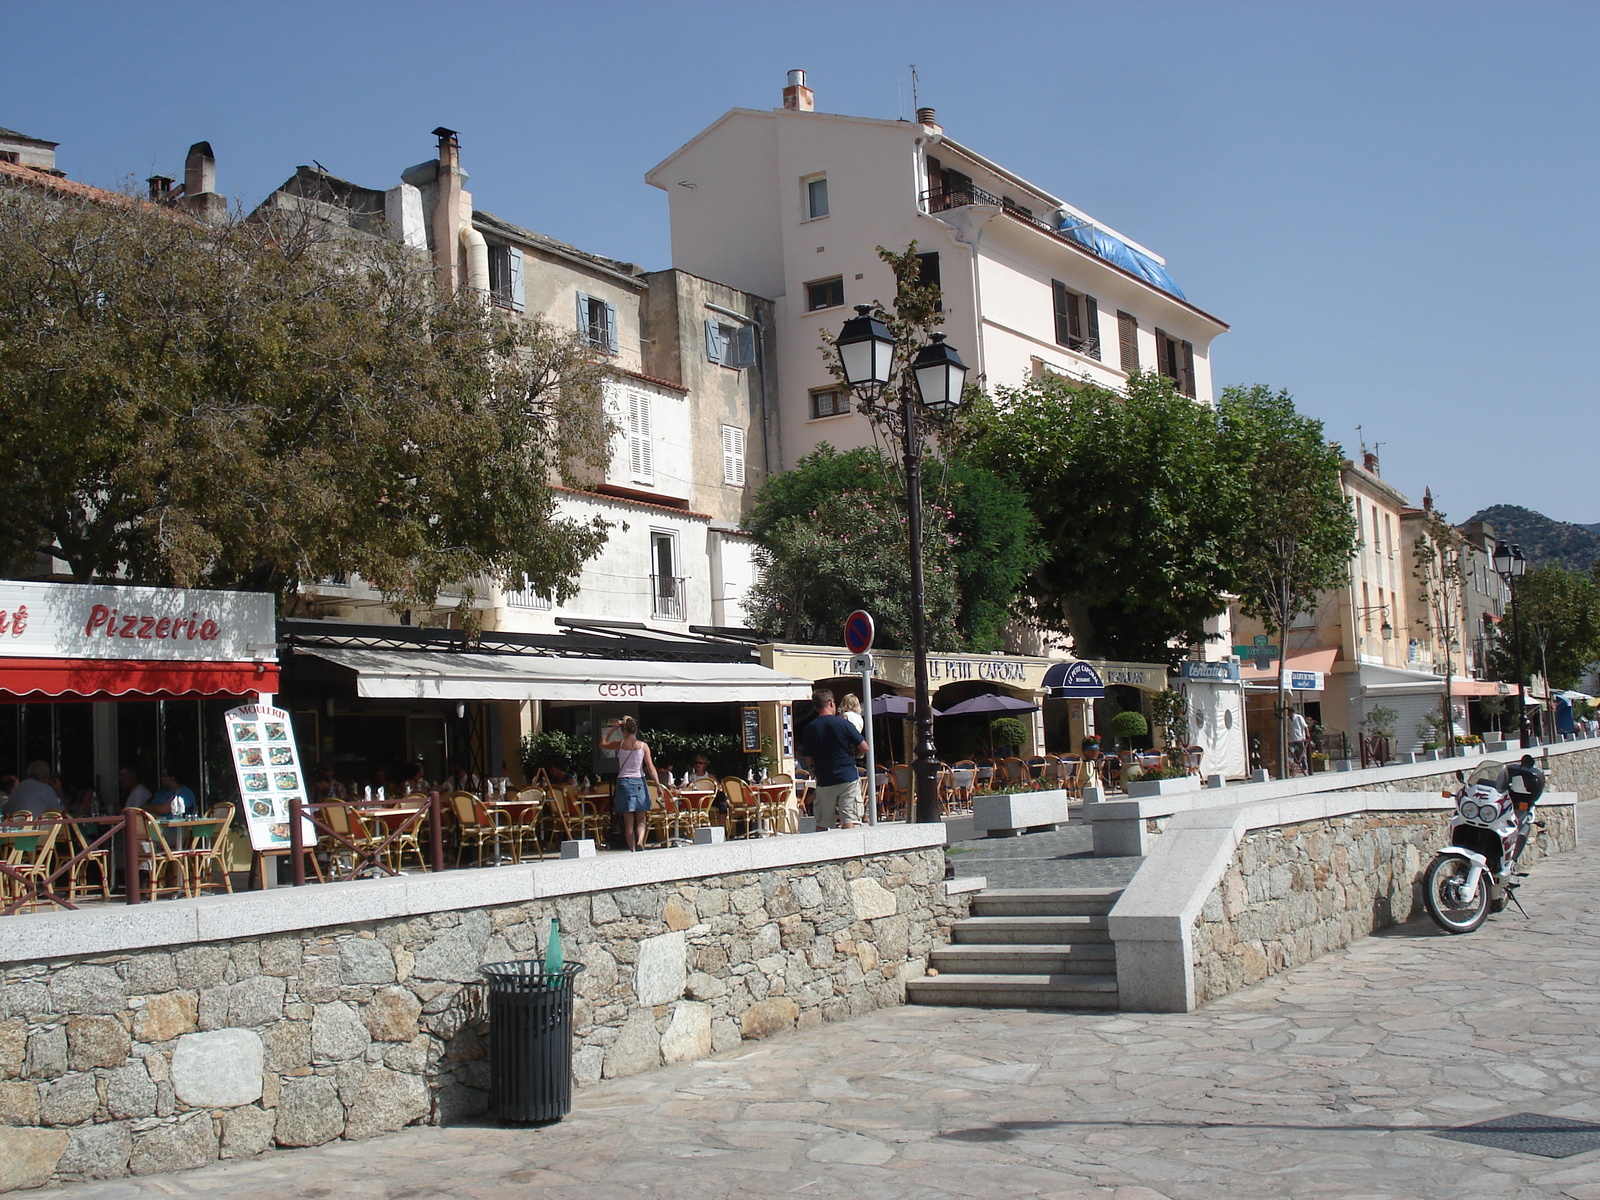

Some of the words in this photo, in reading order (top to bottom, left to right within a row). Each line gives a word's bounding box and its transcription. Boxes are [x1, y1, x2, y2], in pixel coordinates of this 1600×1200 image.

[85, 604, 221, 640] Pizzeria
[929, 661, 941, 680] LE
[945, 661, 972, 680] PETIT
[979, 662, 1026, 682] CAPORAL
[598, 683, 646, 697] cesar
[239, 705, 287, 720] MOULERIE
